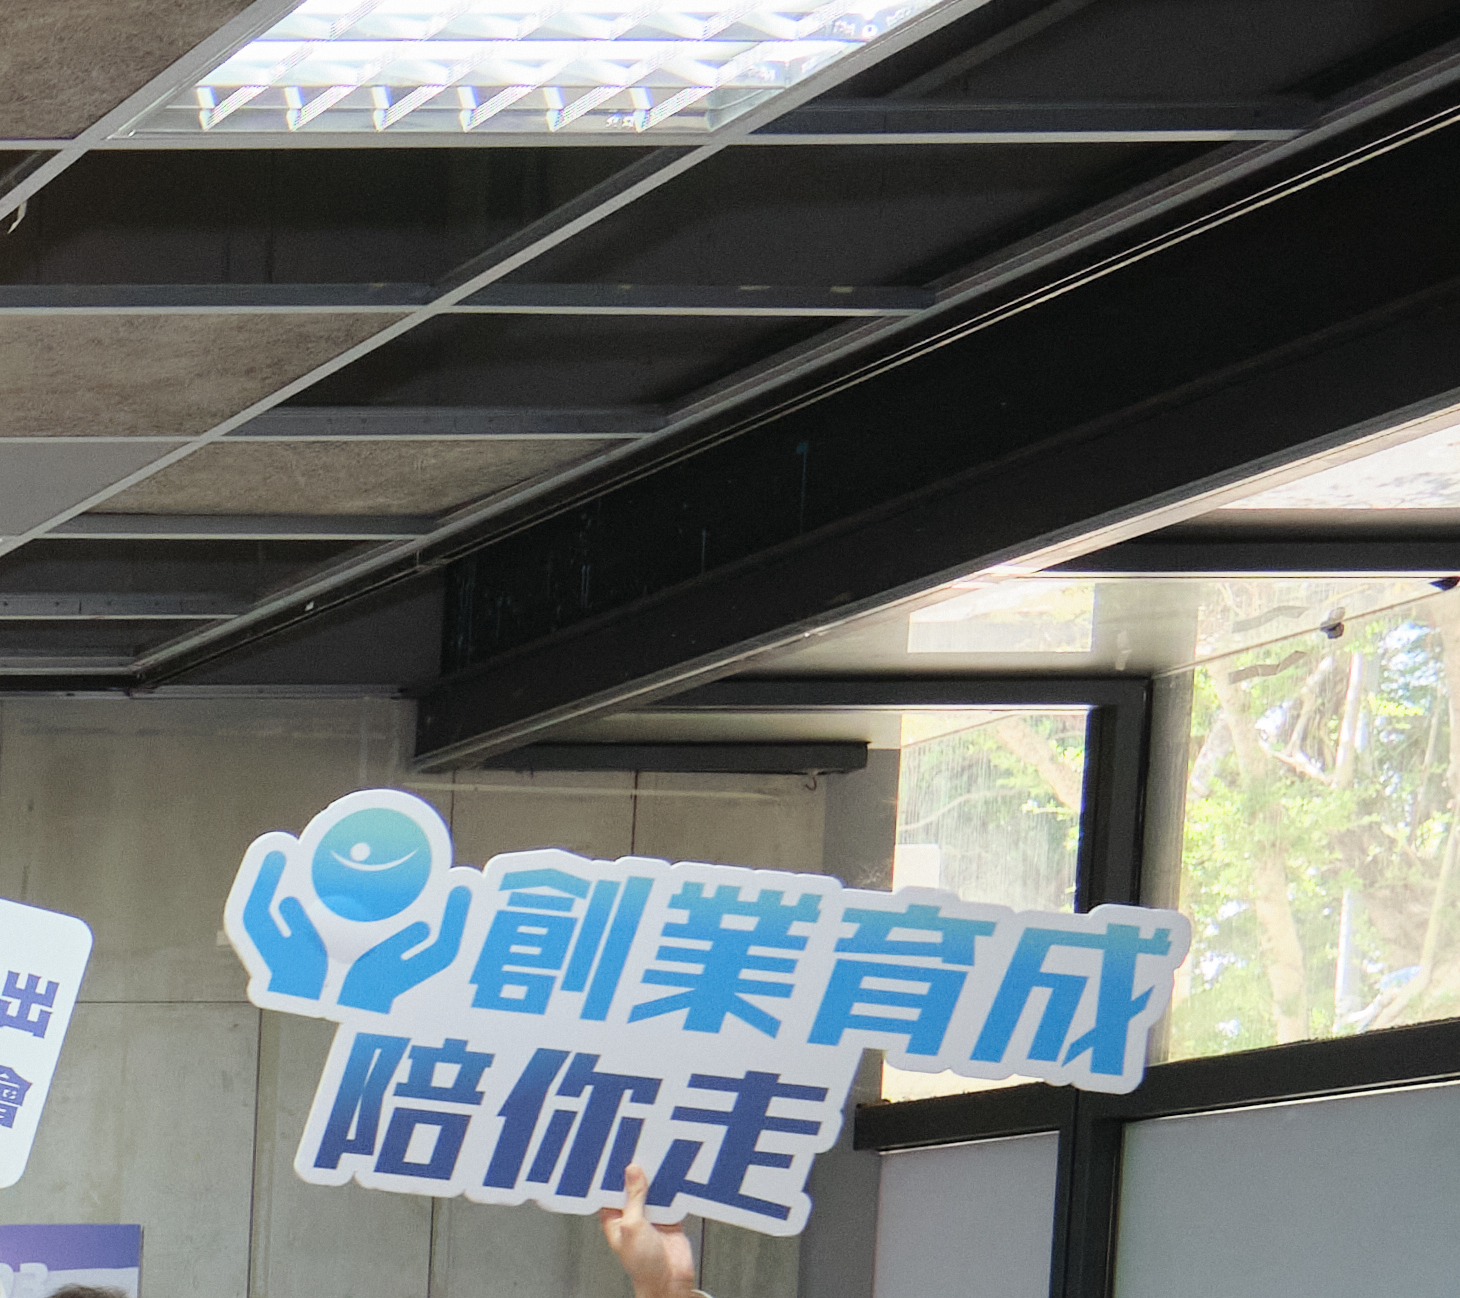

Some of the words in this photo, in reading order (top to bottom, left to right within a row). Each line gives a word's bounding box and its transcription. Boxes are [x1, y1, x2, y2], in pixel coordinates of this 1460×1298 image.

[471, 868, 1174, 1077] 創業育成
[314, 1032, 830, 1221] 陪你走
